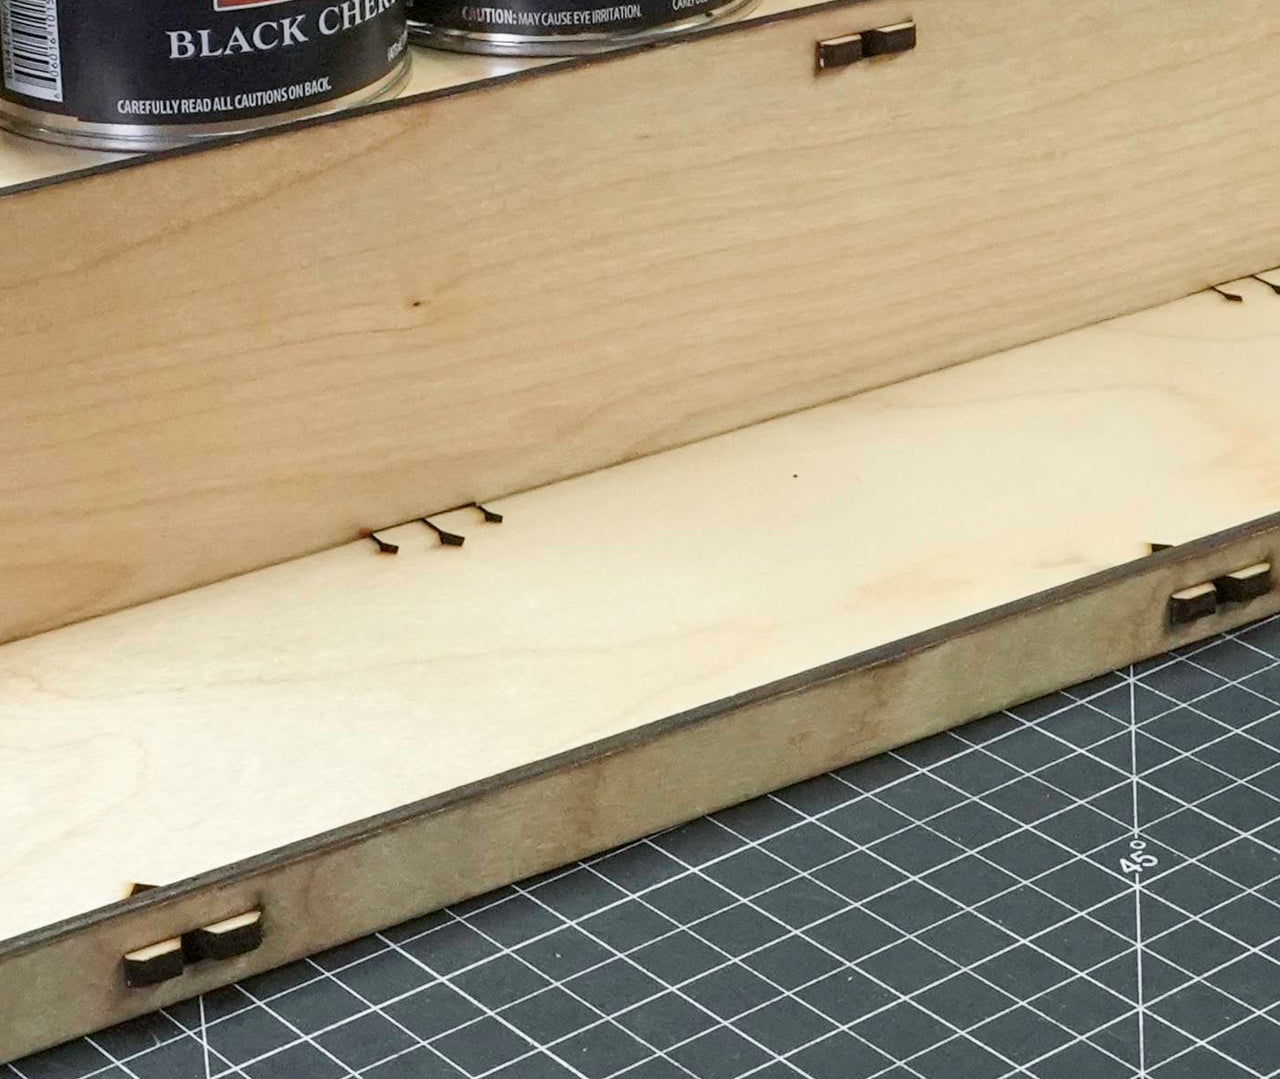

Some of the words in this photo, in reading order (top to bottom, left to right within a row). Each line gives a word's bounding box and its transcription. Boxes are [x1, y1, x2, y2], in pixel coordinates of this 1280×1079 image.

[519, 10, 541, 25] MAY
[541, 9, 573, 25] CAUSE
[573, 8, 591, 24] EYE
[592, 5, 642, 24] IRRITATION.
[166, 14, 308, 59] BLACK
[117, 98, 182, 114] CAREFULLY
[182, 97, 211, 113] READ
[213, 94, 234, 111] ALL
[235, 88, 288, 109] CAUTIONS
[289, 84, 303, 99] ON
[304, 76, 332, 96] BACK.
